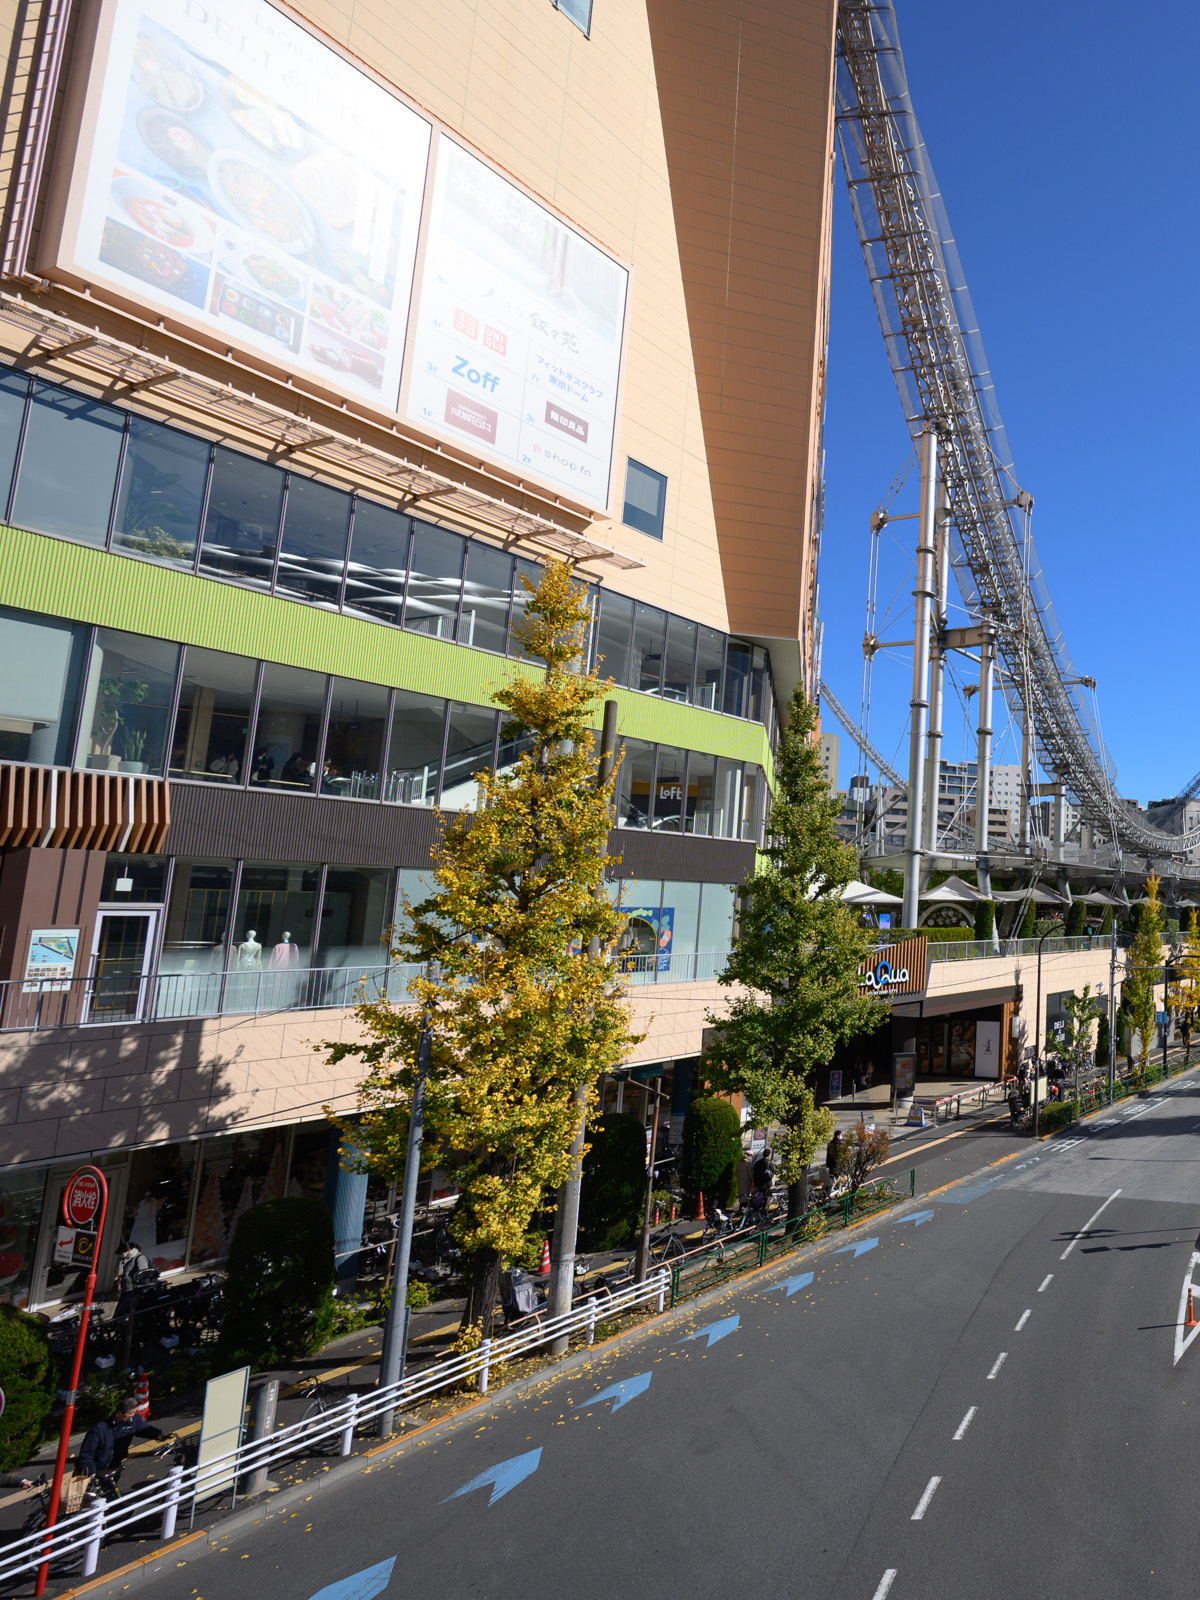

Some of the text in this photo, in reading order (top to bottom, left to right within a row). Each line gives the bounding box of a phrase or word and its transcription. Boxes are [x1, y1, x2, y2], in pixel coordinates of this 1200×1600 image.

[450, 353, 501, 394] Zoff
[535, 353, 605, 399] フィットネスクラブ
[548, 373, 590, 404] 東京ドーム
[550, 409, 586, 437] 無印良品
[521, 453, 533, 465] 2F
[543, 450, 578, 472] shop
[72, 1189, 97, 1210] 消火栓
